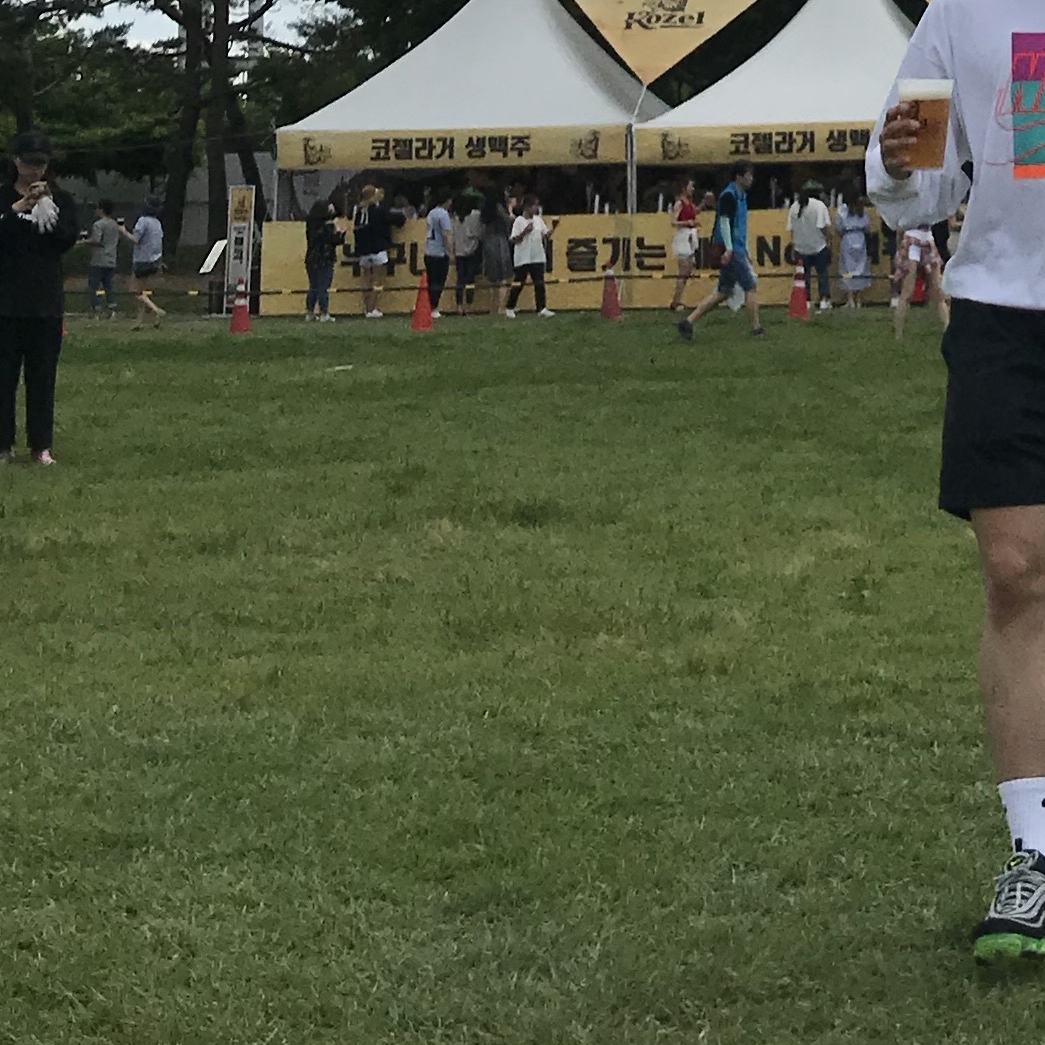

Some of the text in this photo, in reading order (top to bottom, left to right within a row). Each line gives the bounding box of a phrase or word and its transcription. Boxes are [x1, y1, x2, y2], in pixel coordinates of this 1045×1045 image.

[623, 11, 706, 30] Kozel
[370, 134, 532, 162] 코젤라거 생맥주
[729, 128, 871, 156] 코젤라거 생맥
[565, 236, 667, 272] 즐기는
